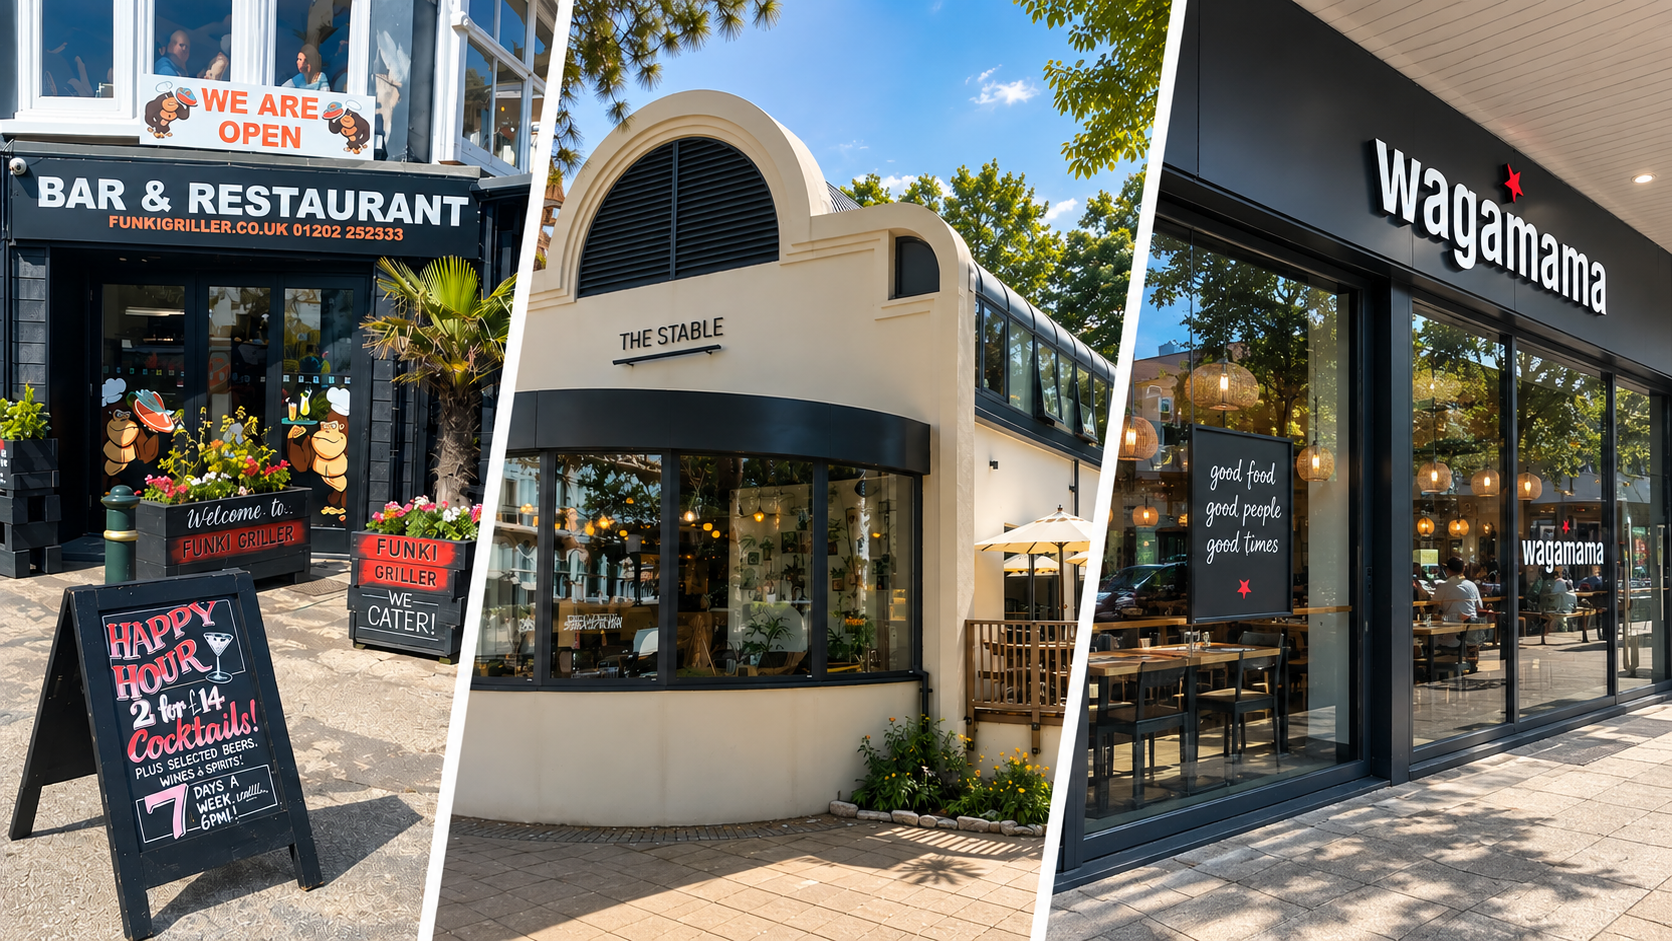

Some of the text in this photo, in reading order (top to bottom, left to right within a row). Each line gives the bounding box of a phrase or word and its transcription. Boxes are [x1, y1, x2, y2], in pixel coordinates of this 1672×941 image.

[201, 87, 319, 121] WE ARE
[218, 120, 302, 149] OPEN
[37, 175, 469, 227] BAR & RESTAURANT
[108, 215, 404, 241] FUNKIGRILLER.CO.UK 01202 252333
[1375, 138, 1607, 315] wagamama
[619, 316, 724, 351] THE STABLE
[1210, 458, 1276, 491] good food
[1205, 494, 1282, 528] good people
[182, 525, 294, 559] FUNKI GRILLER
[377, 538, 437, 562] FUNKI
[1206, 530, 1279, 565] good times
[1521, 539, 1604, 574] wagamama
[374, 565, 437, 587] GRILLER
[388, 589, 413, 608] WE
[106, 600, 216, 660] HAPPY
[368, 605, 436, 636] CATER!
[111, 638, 213, 701] HOUR
[130, 685, 226, 730] 2 for £14
[127, 699, 259, 764] Cocktails!
[135, 762, 164, 780] PLUS
[168, 748, 218, 771] SELECTED
[159, 767, 195, 788] WINES
[205, 755, 244, 774] SPIRITS!
[193, 780, 224, 800] DAYS
[230, 775, 239, 789] A
[144, 783, 189, 840] 7
